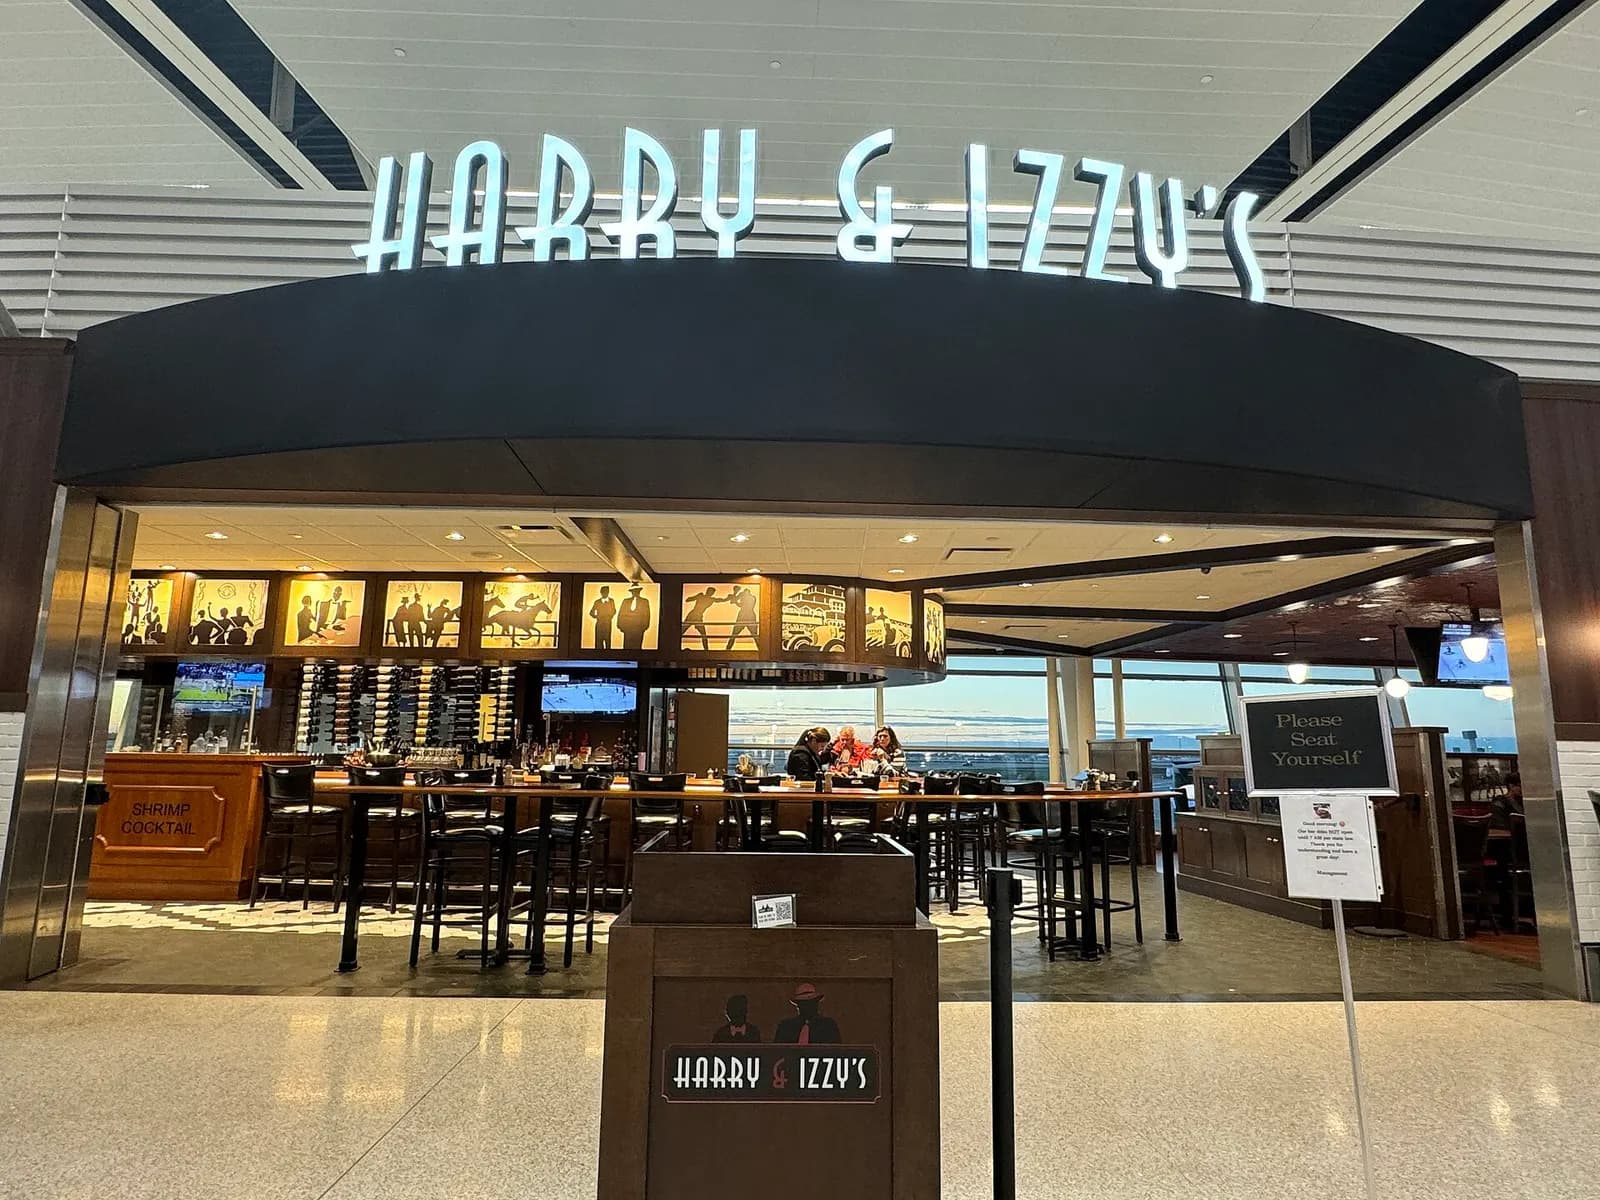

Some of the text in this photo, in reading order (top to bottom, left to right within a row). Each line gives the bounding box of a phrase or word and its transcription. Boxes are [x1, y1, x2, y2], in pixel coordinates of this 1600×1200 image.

[351, 127, 1266, 303] HARRY & IZZY'S
[1276, 712, 1343, 729] Please
[1290, 731, 1338, 748] Seat
[1271, 749, 1363, 768] Yourself
[131, 802, 191, 816] SHRIMP
[121, 820, 196, 836] COCKTAIL
[673, 1056, 867, 1089] HARRY & IZZY'S
